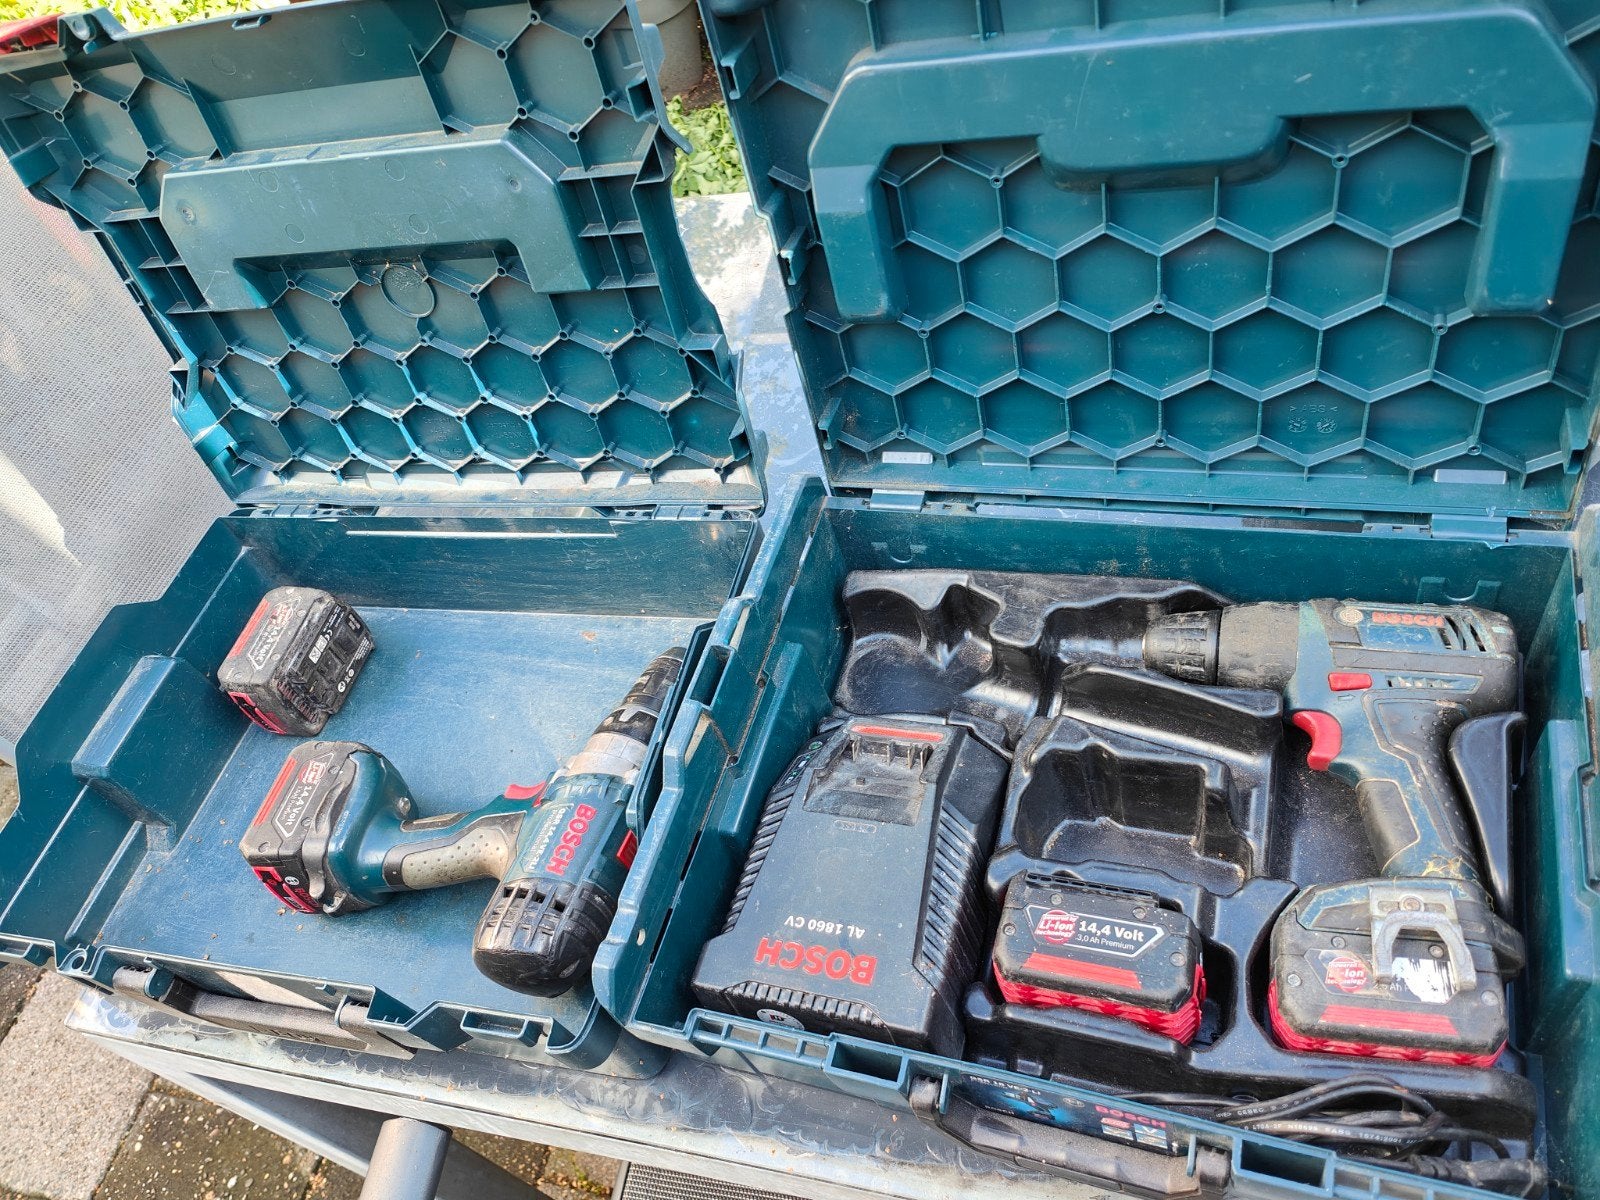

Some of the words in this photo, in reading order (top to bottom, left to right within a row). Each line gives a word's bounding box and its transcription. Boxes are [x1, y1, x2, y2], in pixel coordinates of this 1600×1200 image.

[285, 806, 301, 826] Volt
[547, 804, 597, 875] BOSCH
[784, 915, 805, 928] CV
[808, 919, 843, 935] 1860
[1039, 919, 1073, 931] Li-Ion
[847, 925, 865, 939] AL
[1078, 920, 1112, 937] 14,4
[1113, 926, 1145, 942] Volt
[1089, 936, 1100, 944] Ah
[1101, 938, 1135, 950] Premium
[754, 938, 877, 986] BOSCH
[1390, 983, 1402, 992] Ah
[1094, 1104, 1167, 1129] BOSCH
